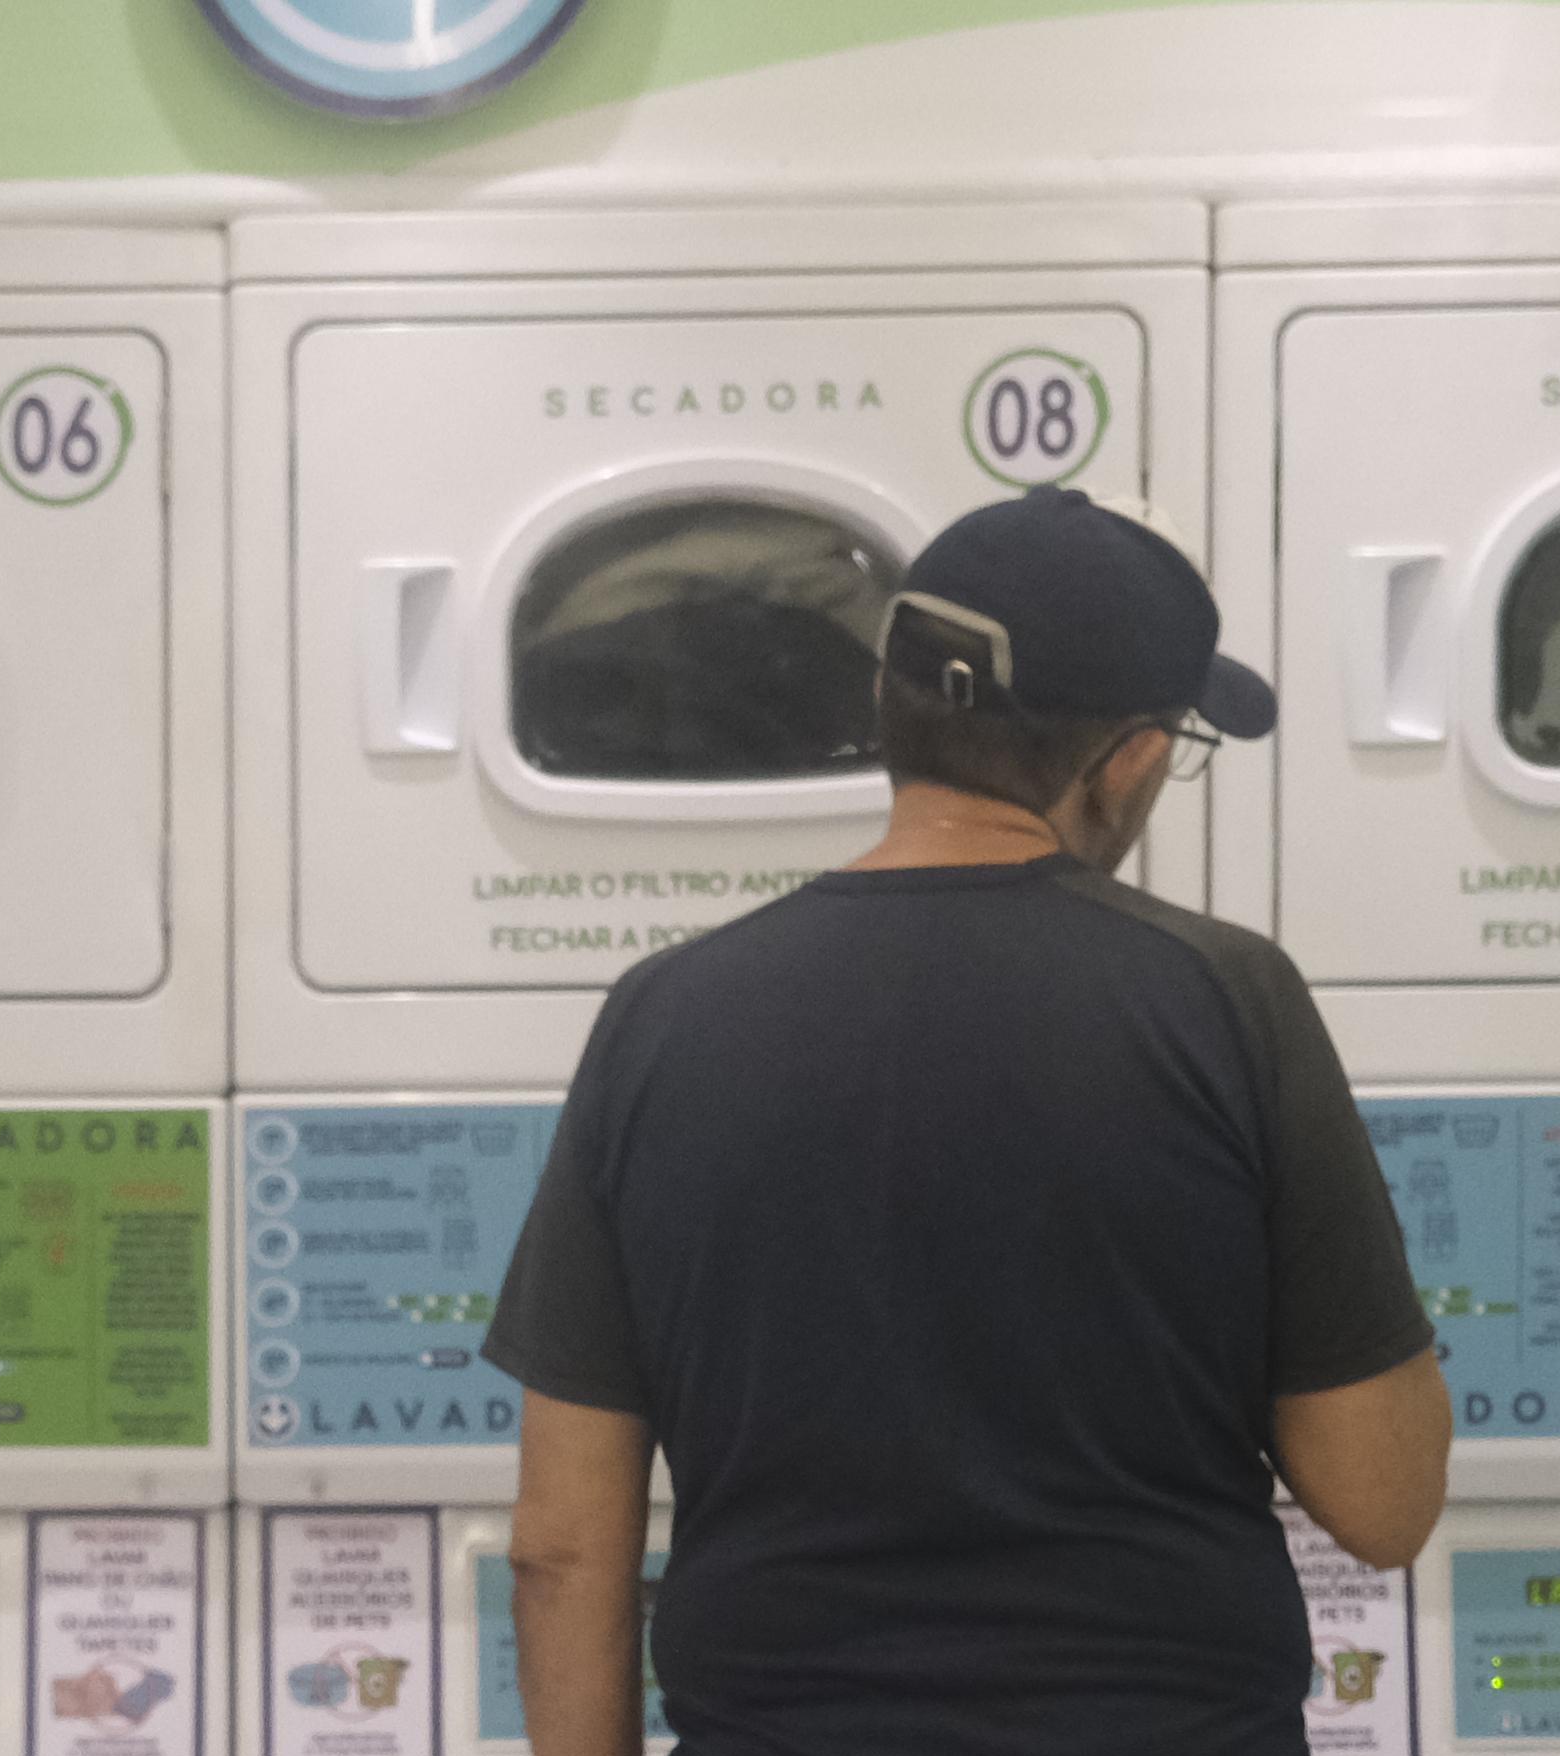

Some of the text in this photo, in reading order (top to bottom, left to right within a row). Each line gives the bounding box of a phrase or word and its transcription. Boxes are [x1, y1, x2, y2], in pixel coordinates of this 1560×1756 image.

[543, 383, 885, 417] SECADORA
[988, 376, 1076, 459] 08
[13, 397, 102, 474] 06
[474, 869, 825, 900] LIMPAR O FILTRO ANT
[491, 926, 613, 953] FECHAR
[620, 926, 639, 948] A
[310, 1397, 515, 1436] LAVAD
